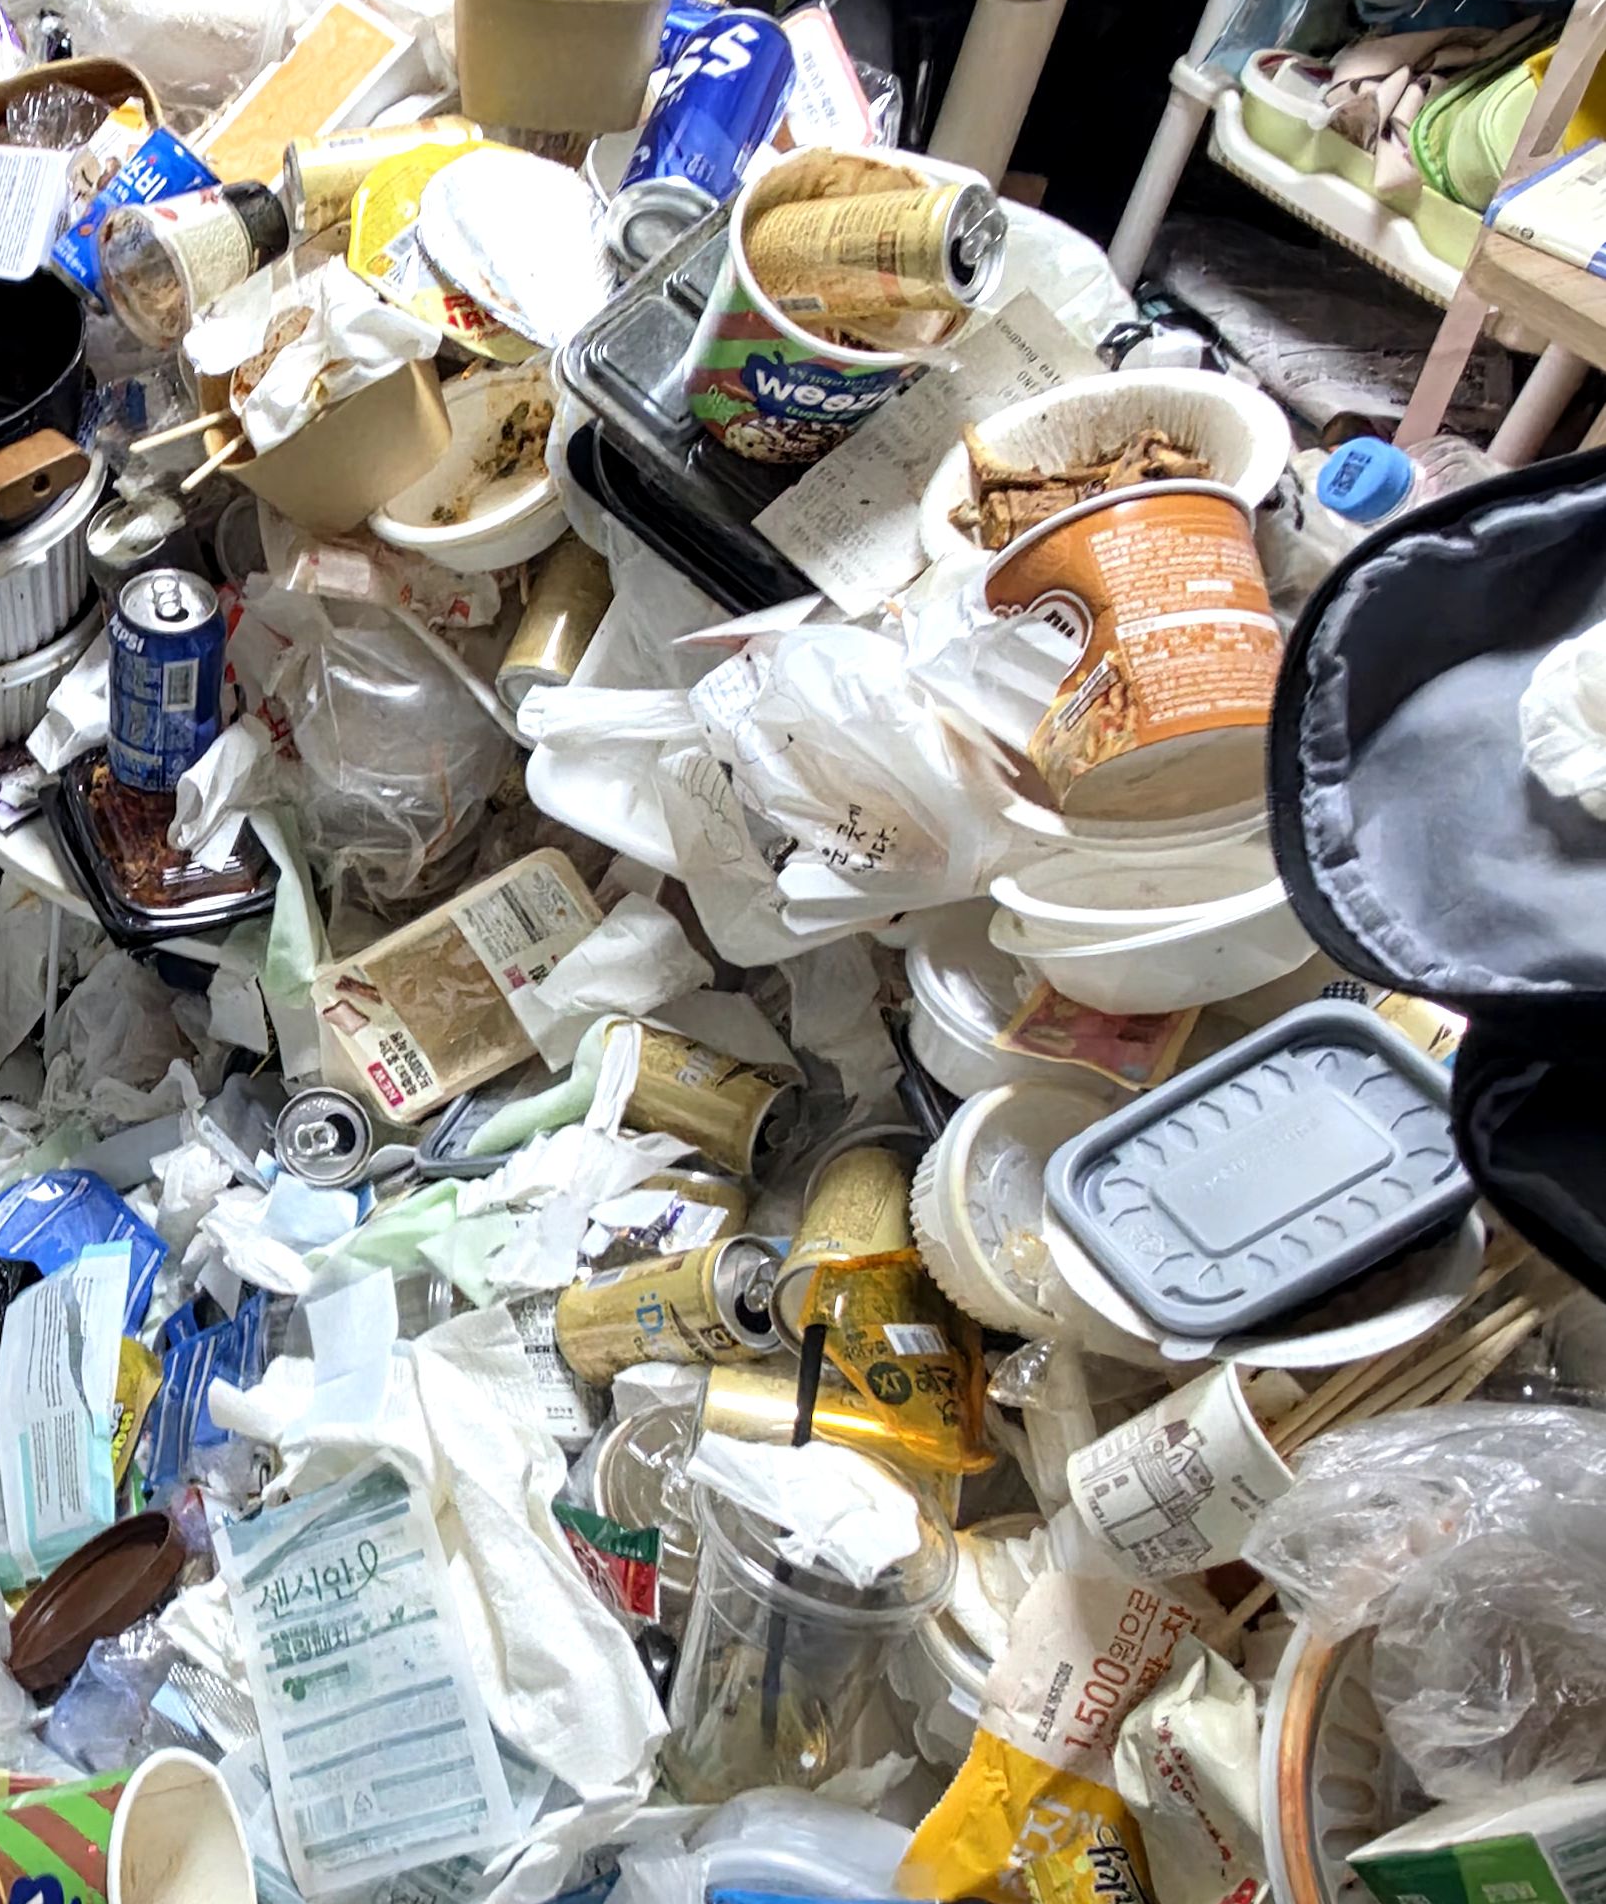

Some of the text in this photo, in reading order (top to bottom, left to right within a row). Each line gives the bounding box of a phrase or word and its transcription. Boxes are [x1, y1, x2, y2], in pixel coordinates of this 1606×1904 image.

[756, 369, 891, 416] weez
[108, 613, 145, 652] PEPSI
[369, 1063, 399, 1105] NEW
